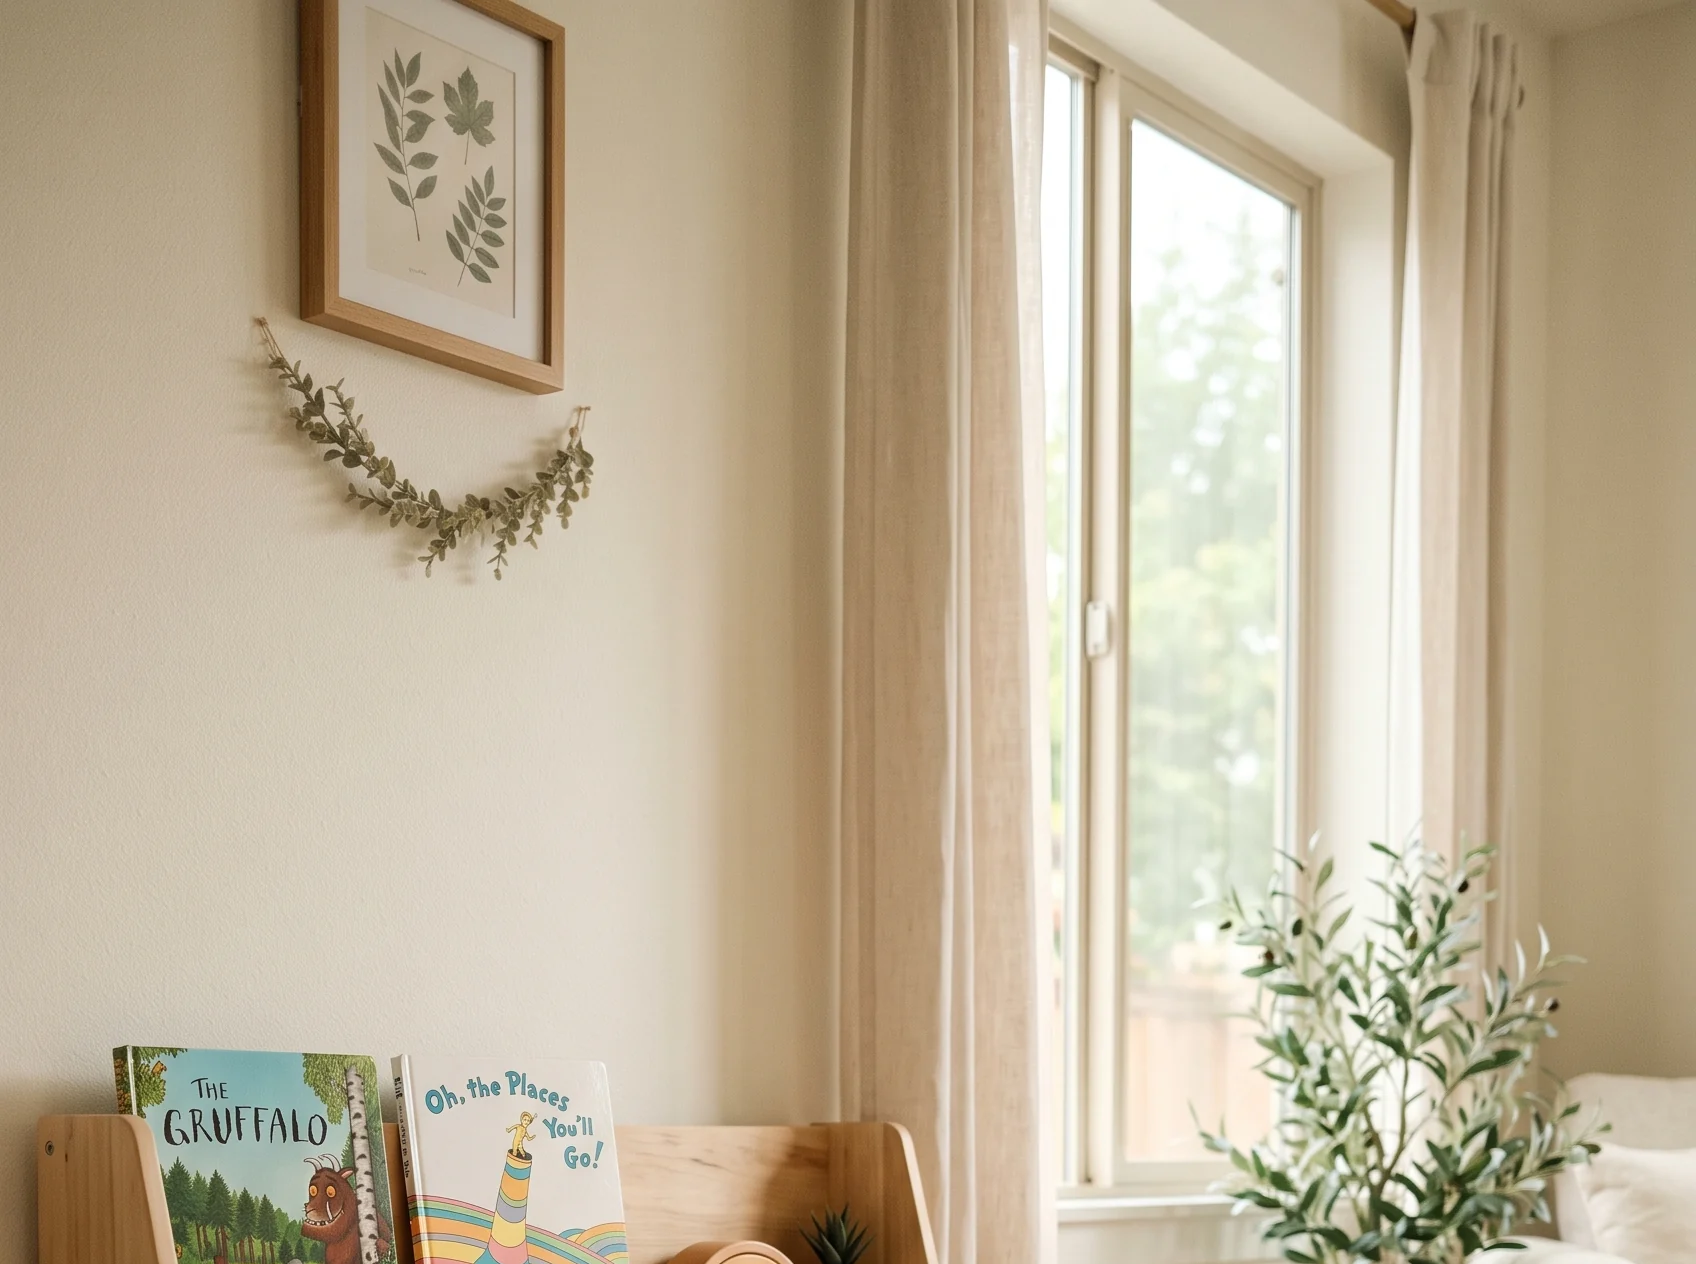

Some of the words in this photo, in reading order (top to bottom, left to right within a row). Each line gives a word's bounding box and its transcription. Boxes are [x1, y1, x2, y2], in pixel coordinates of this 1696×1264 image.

[191, 1077, 229, 1101] THE
[425, 1085, 465, 1114] Oh,
[466, 1077, 501, 1098] the
[505, 1070, 570, 1112] Places
[163, 1106, 328, 1146] GRUFFALO
[542, 1115, 593, 1138] You'll
[563, 1141, 604, 1169] Go!
